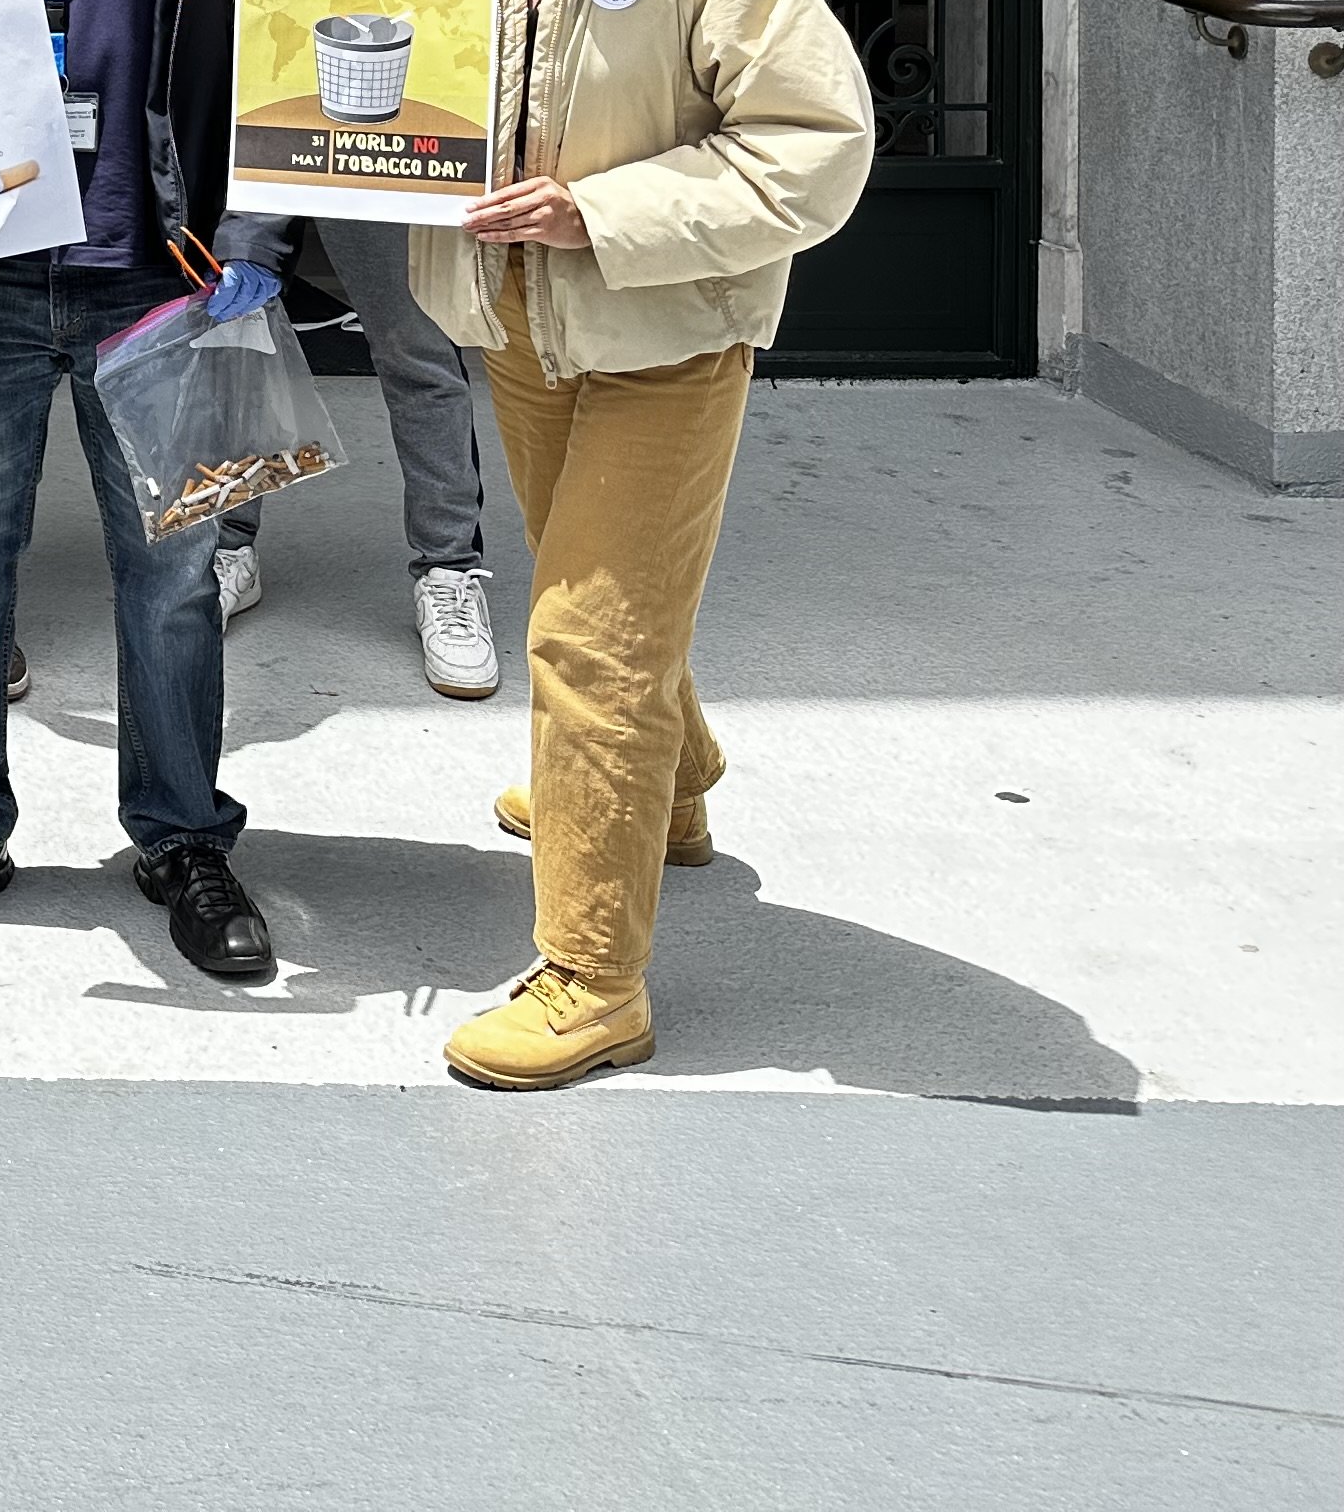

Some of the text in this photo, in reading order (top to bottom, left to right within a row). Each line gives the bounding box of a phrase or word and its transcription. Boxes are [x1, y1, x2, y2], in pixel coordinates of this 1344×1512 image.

[311, 135, 325, 147] 31
[335, 132, 439, 154] WORLD NO
[291, 153, 324, 167] MAY
[335, 154, 468, 179] TOBACCO DAY
